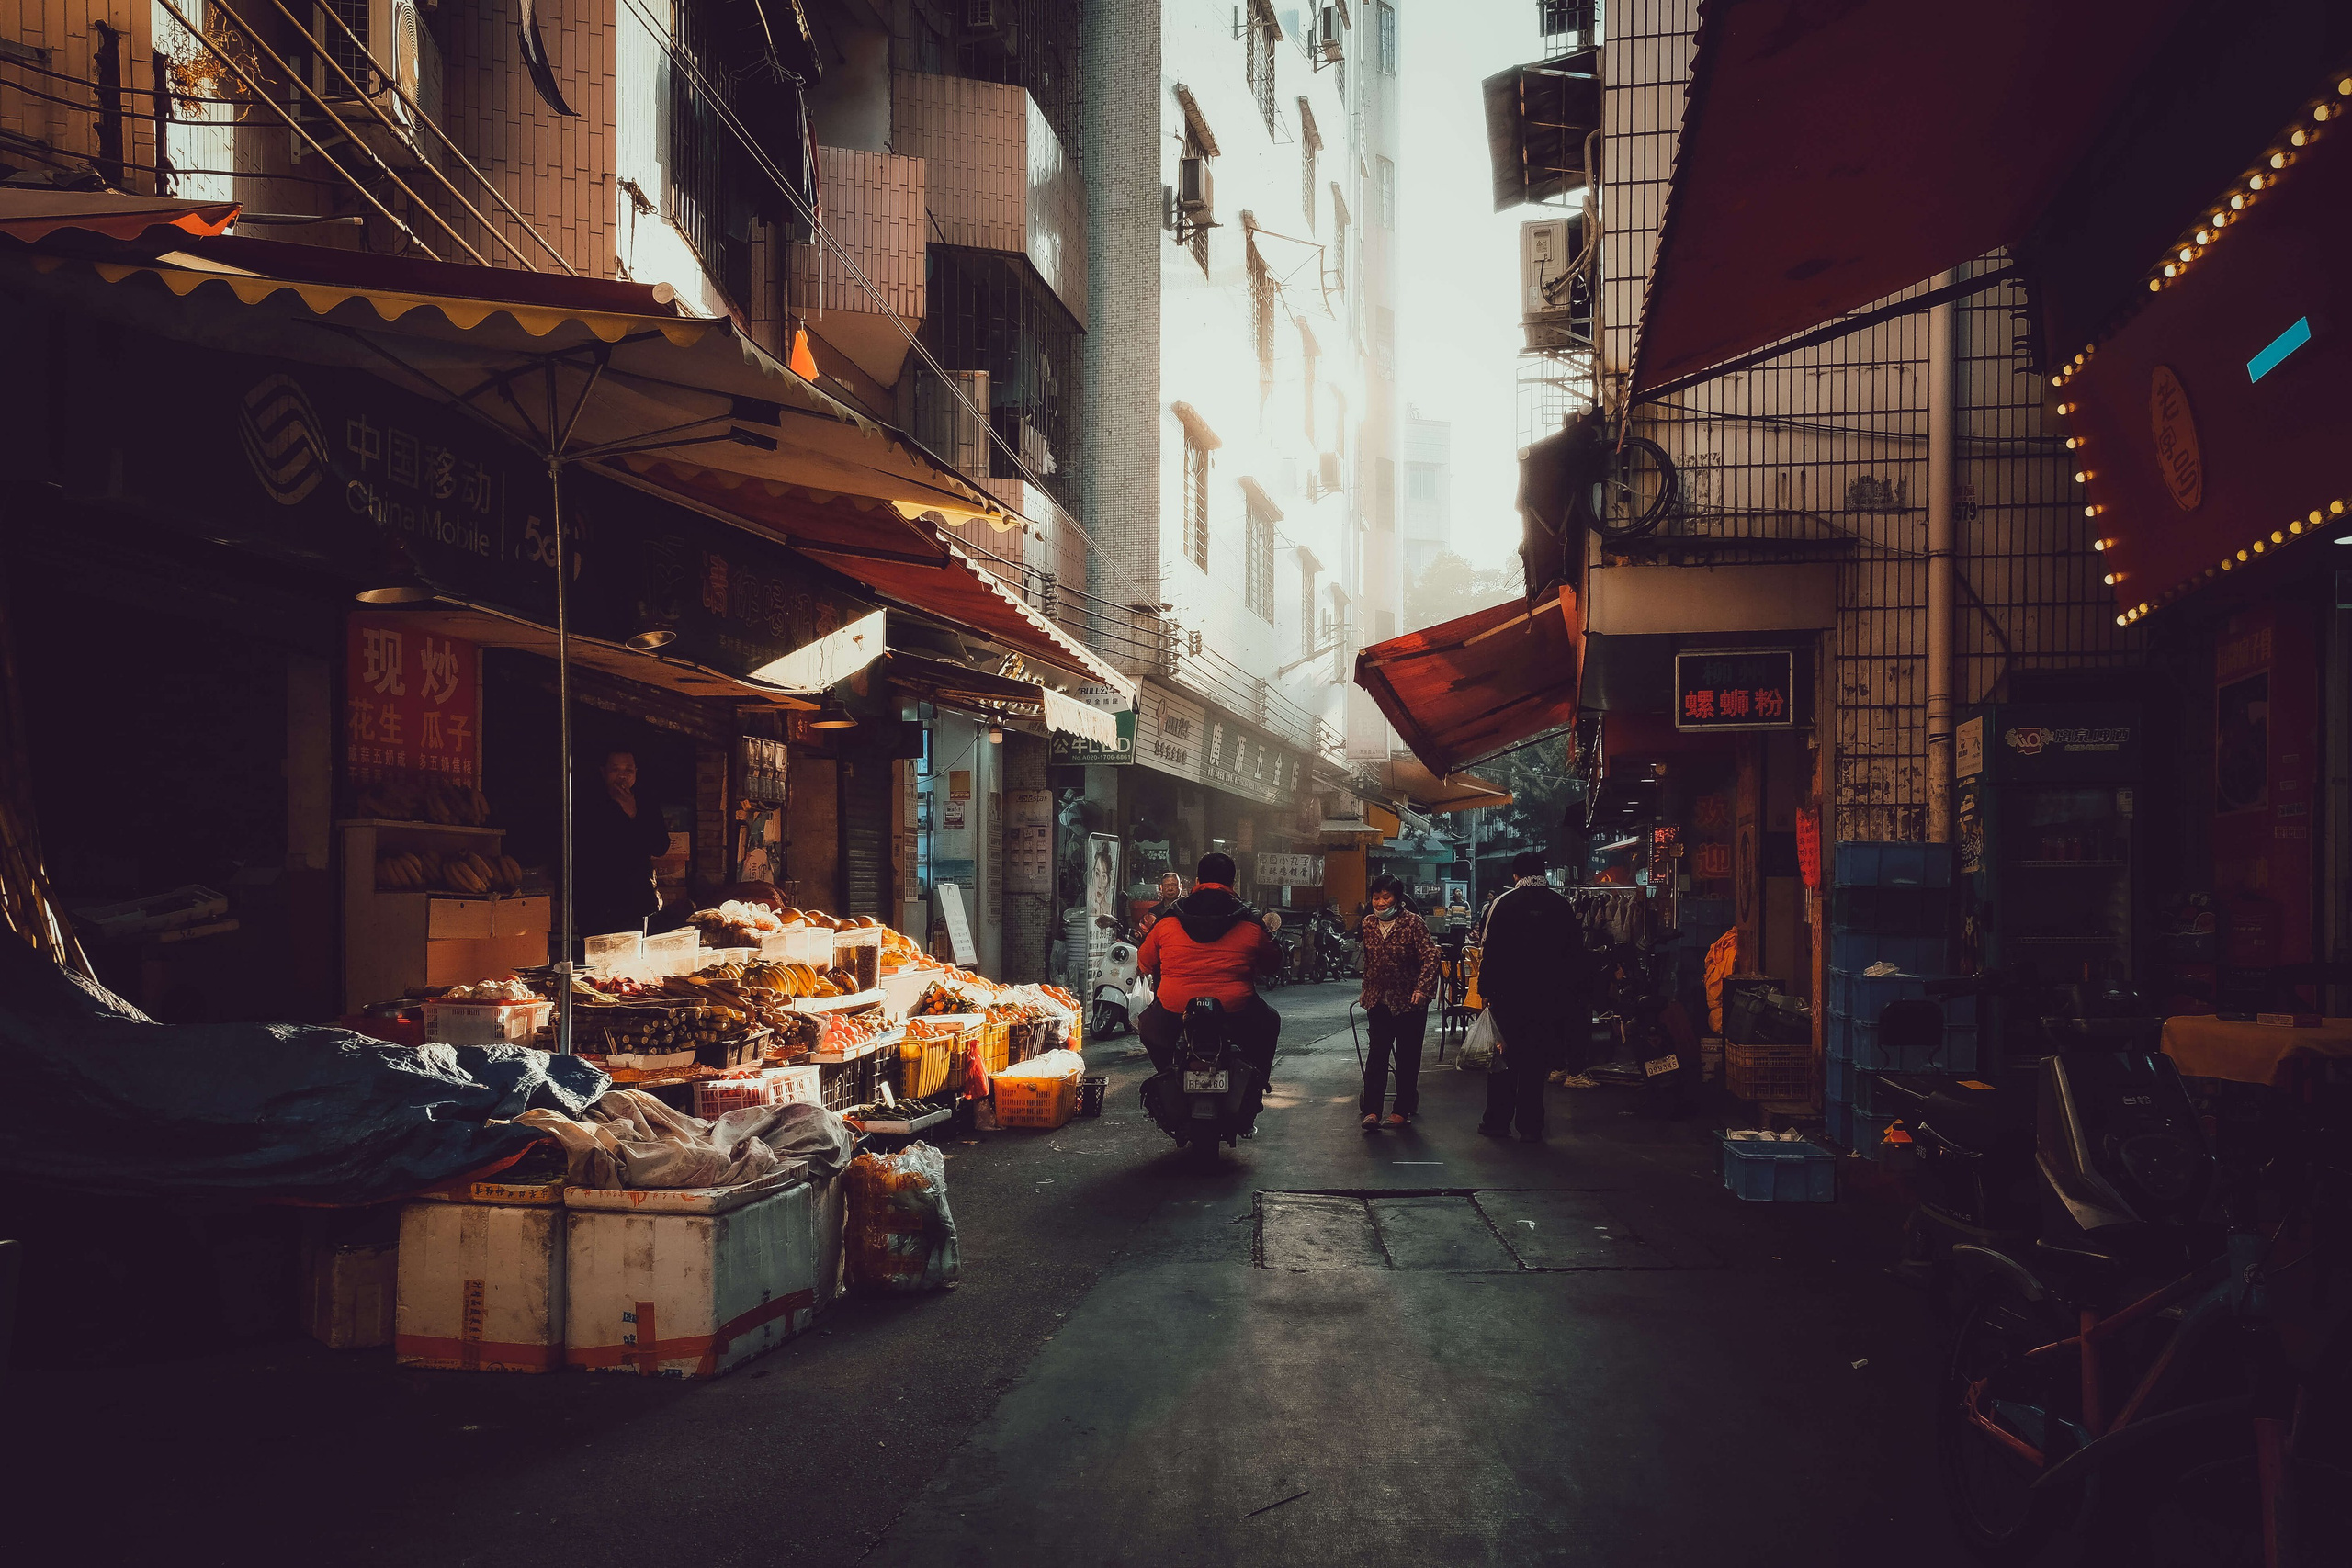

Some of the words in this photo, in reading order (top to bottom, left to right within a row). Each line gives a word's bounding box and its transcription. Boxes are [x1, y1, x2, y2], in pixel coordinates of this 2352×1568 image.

[347, 412, 491, 514] 中国移动
[346, 479, 415, 533] China
[422, 504, 490, 558] Mobile
[362, 627, 459, 705] 现炒
[1702, 660, 1769, 685] 柳州
[347, 695, 404, 745] 花生
[421, 711, 472, 752] 瓜子
[1685, 687, 1784, 718] 螺蛳粉
[2053, 728, 2132, 743] 漓泉啤酒
[1696, 794, 1734, 879] 欢迎
[1948, 1208, 1973, 1223] TAILG
